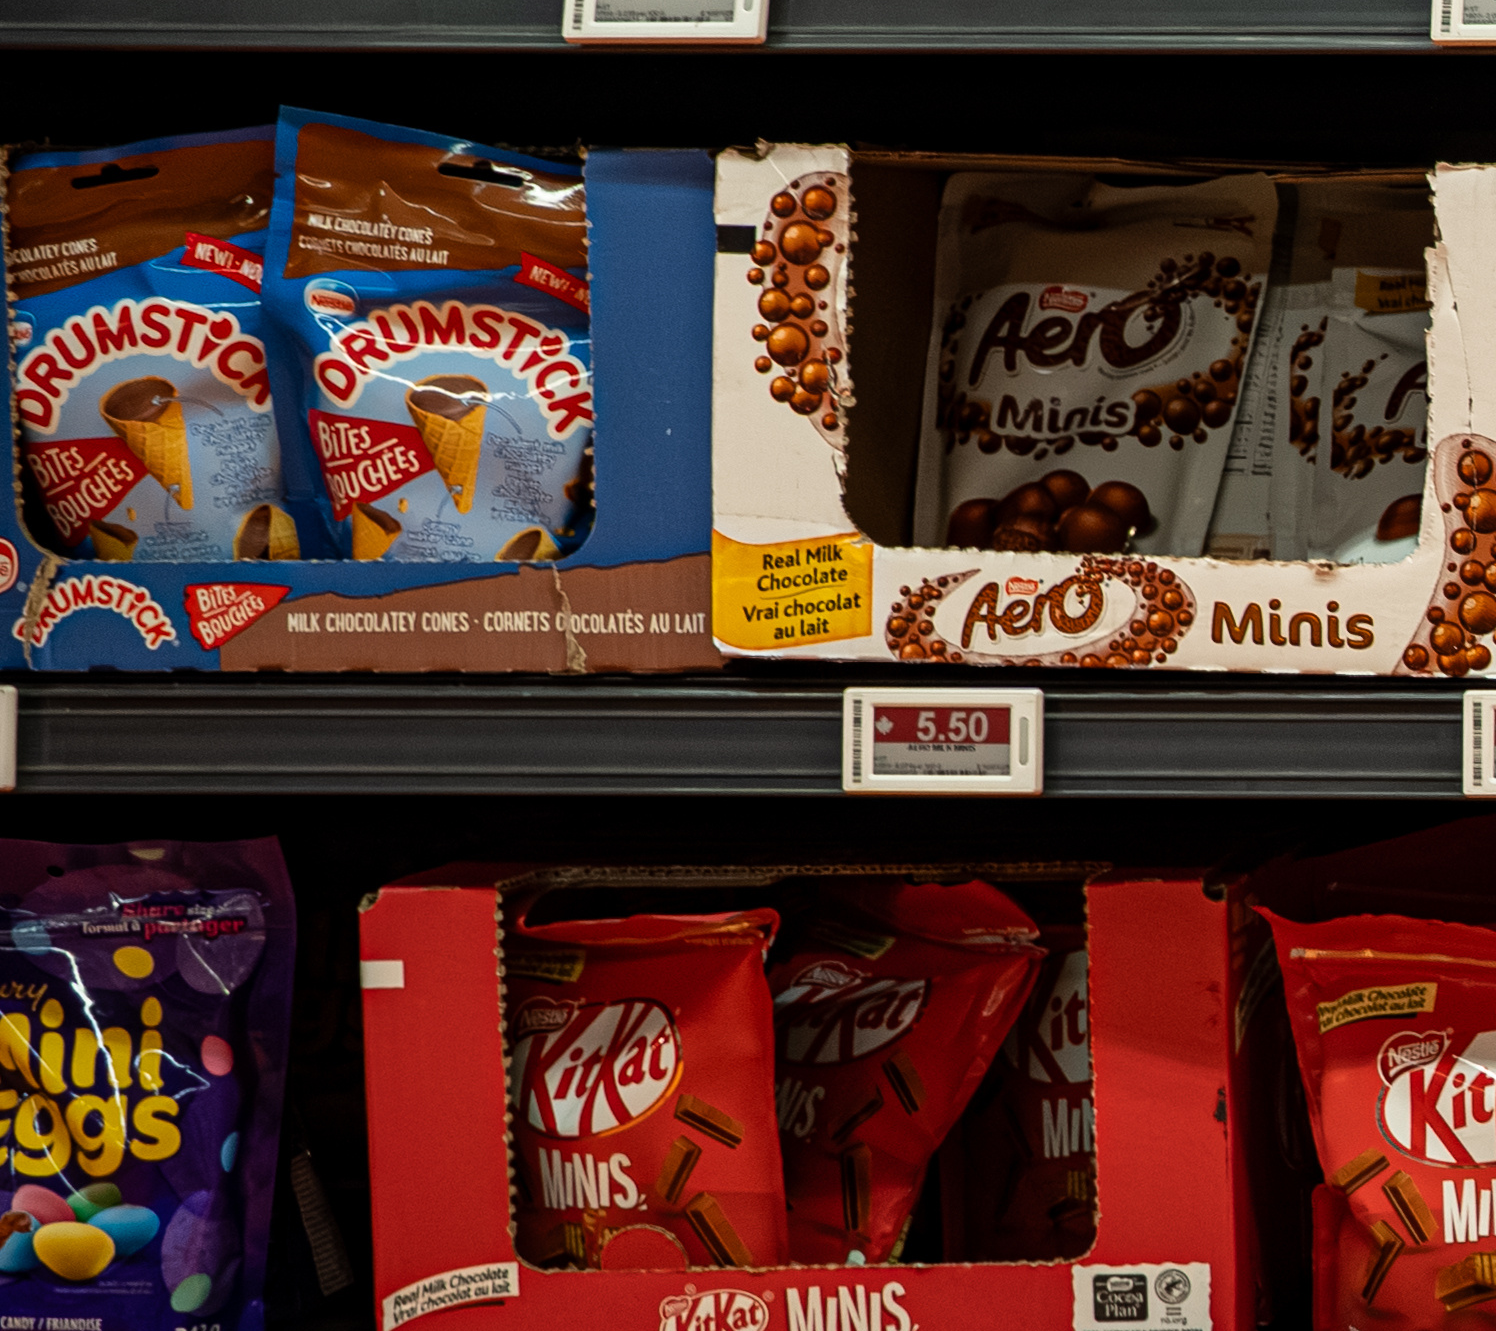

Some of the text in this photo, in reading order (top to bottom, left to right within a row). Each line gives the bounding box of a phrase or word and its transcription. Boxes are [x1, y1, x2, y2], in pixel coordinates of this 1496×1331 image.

[762, 547, 842, 570] Real Milk
[756, 566, 848, 592] Chocolate
[742, 592, 861, 623] Vrai chocolat
[288, 611, 705, 632] MILK CHOCOLATEY CONES CORNETS COCOLATÉS AU LAIT
[773, 617, 830, 639] au lait
[1210, 600, 1373, 649] Minis
[917, 712, 989, 743] 5.50
